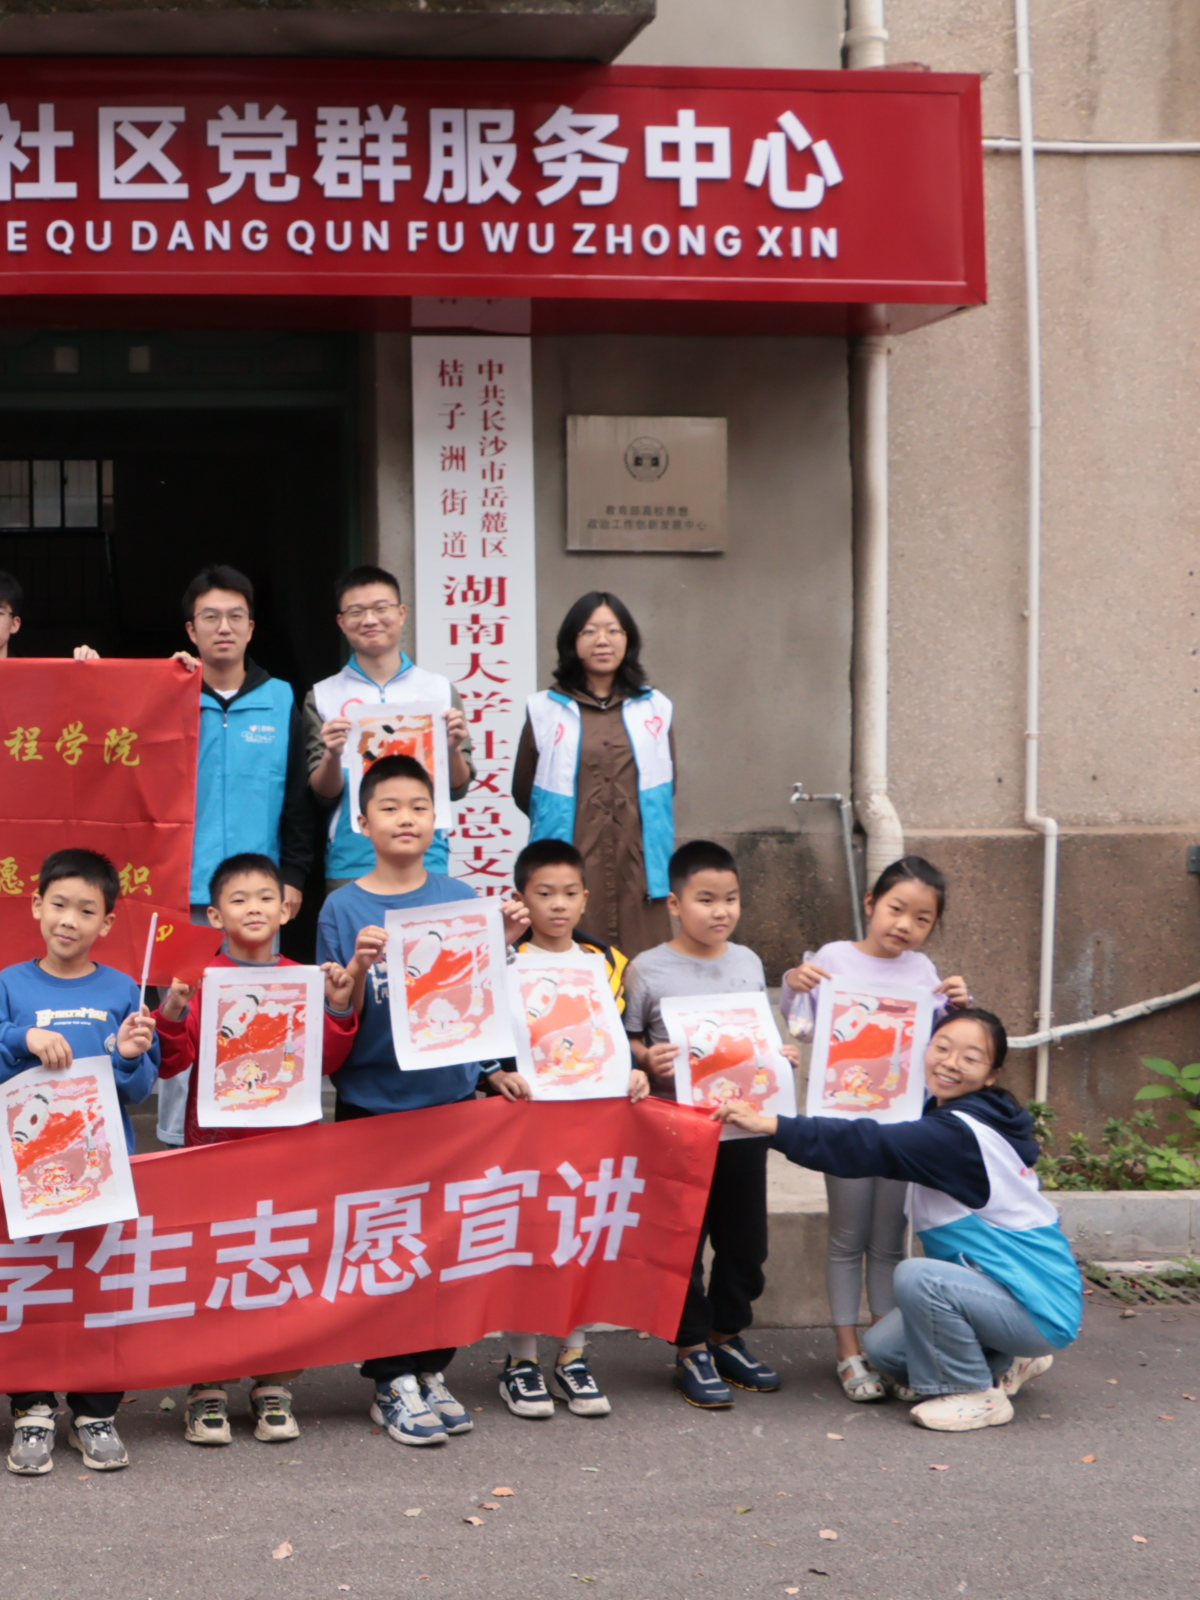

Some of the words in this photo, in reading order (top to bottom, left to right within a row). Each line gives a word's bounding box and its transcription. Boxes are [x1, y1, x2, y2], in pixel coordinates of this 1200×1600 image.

[47, 220, 111, 254] QU
[132, 220, 268, 250] DANG
[287, 220, 389, 254] QUN
[409, 221, 463, 251] FU
[482, 222, 554, 253] WU
[573, 223, 741, 256] ZHONG
[758, 226, 837, 258] XIN
[438, 359, 467, 558] 桔子洲街道
[477, 359, 508, 558] 中共长沙市岳麓区
